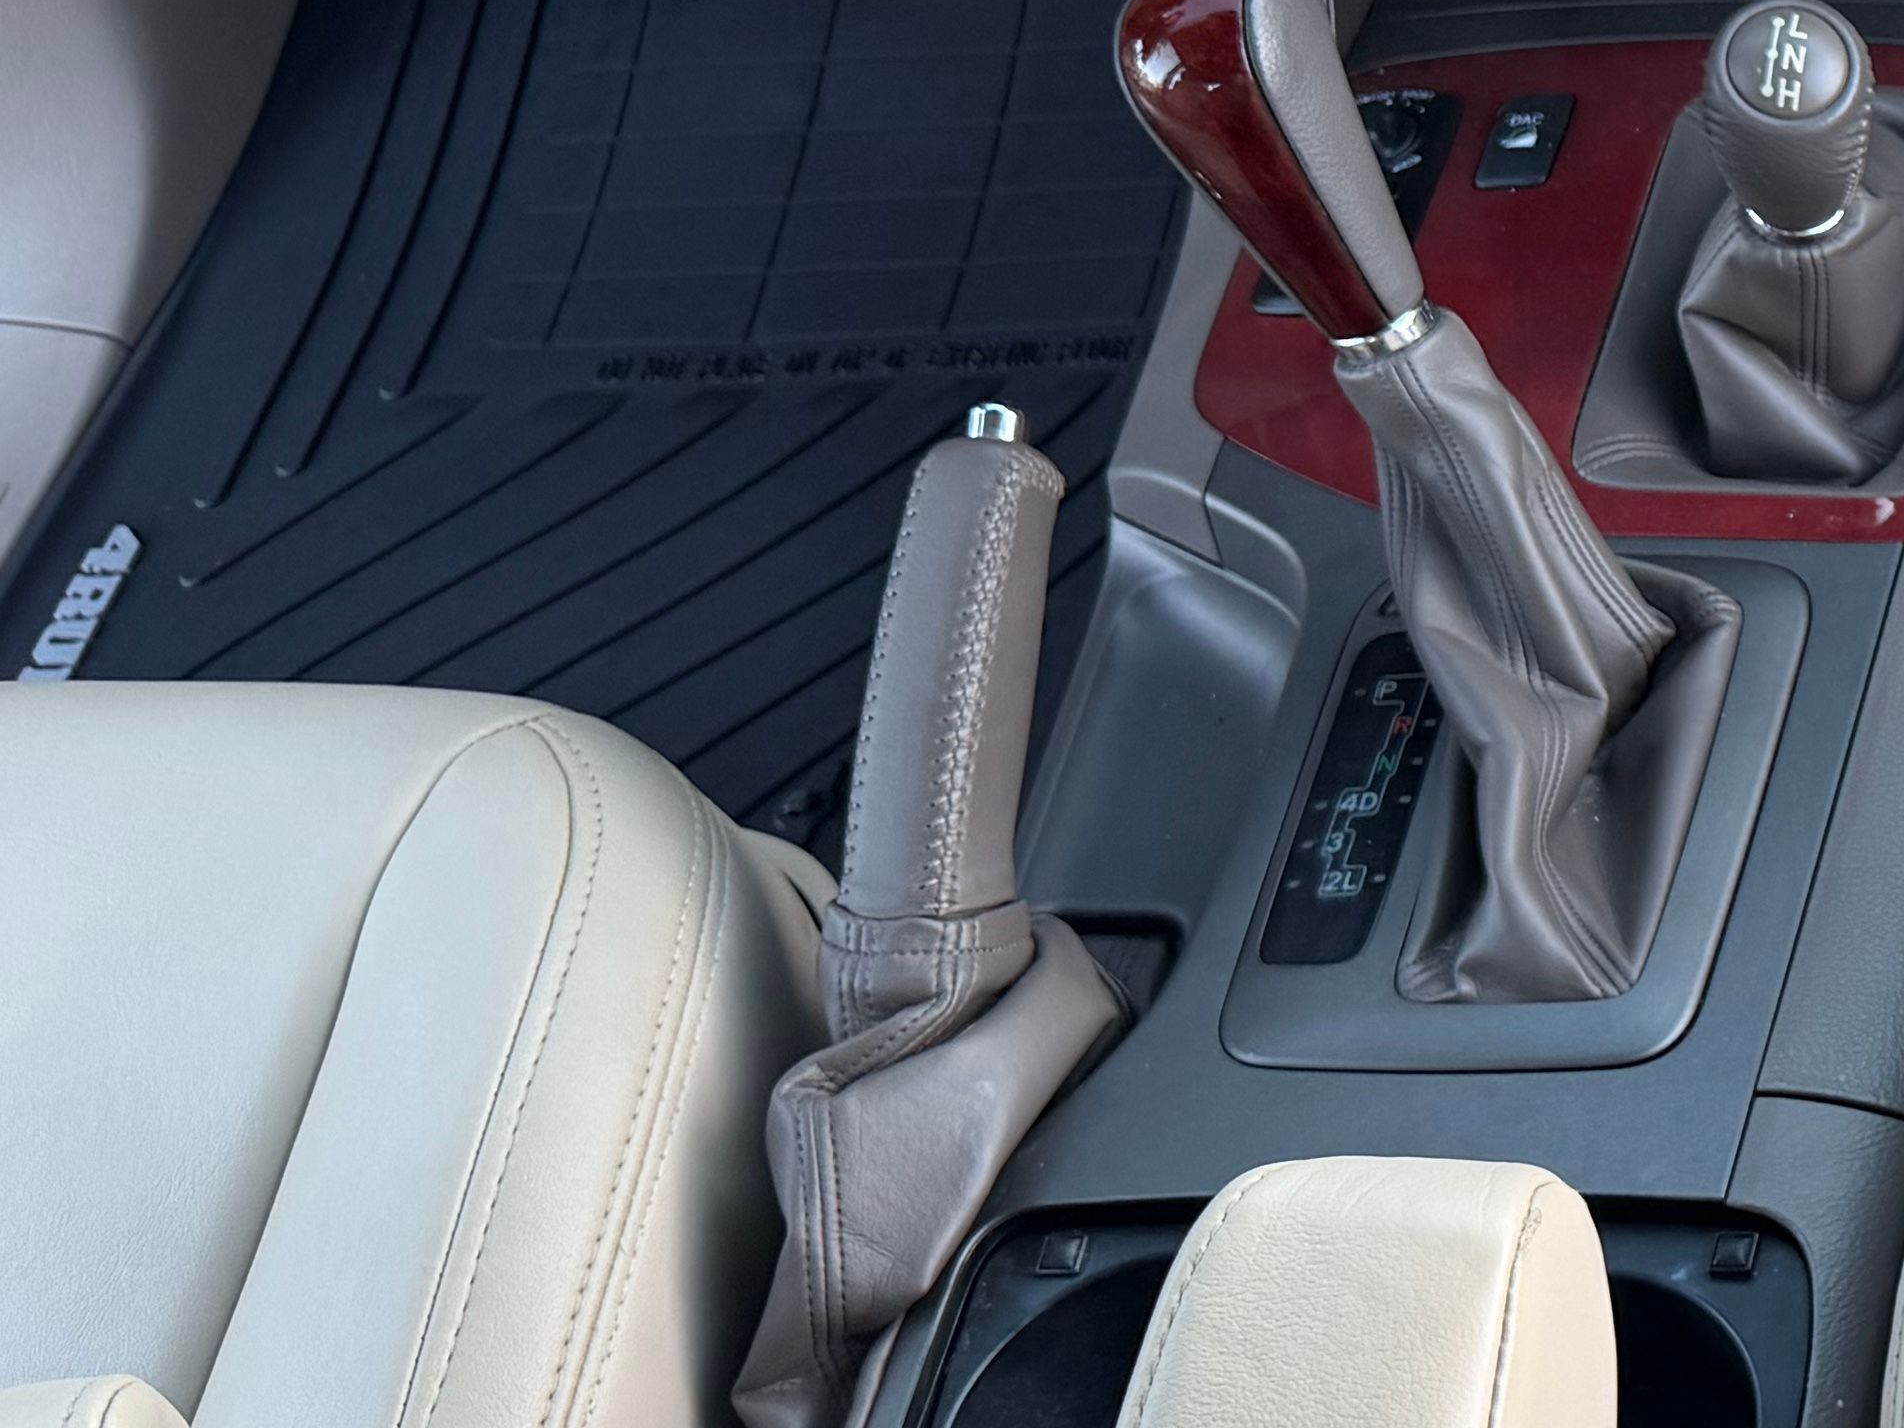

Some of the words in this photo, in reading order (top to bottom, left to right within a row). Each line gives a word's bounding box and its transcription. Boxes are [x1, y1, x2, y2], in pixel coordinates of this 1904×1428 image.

[1789, 14, 1807, 40] L
[1783, 44, 1807, 72] N
[1776, 80, 1801, 112] H
[1377, 680, 1398, 700] P
[1377, 754, 1398, 771] N
[1326, 832, 1345, 853] 3
